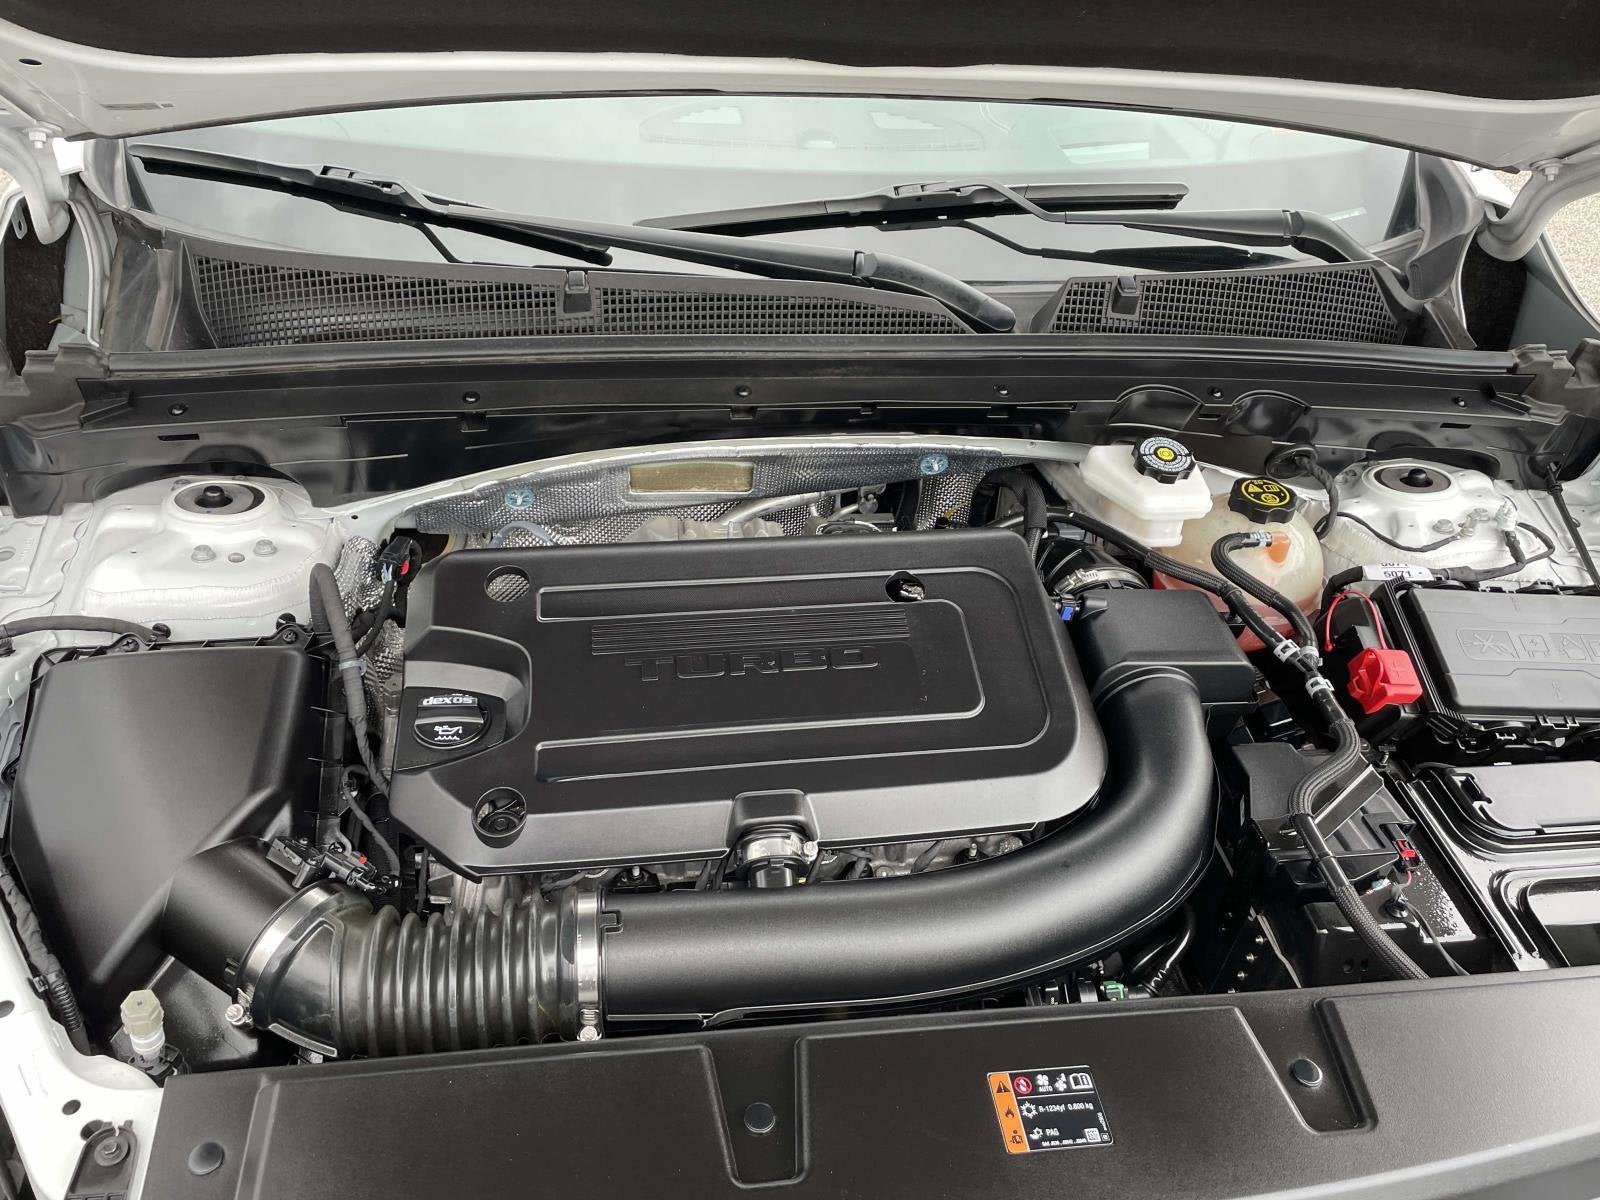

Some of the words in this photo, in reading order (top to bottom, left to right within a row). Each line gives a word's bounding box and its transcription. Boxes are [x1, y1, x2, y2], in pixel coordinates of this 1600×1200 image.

[624, 645, 880, 682] TURBO
[422, 696, 473, 706] dexos
[1046, 1128, 1060, 1137] PAG
